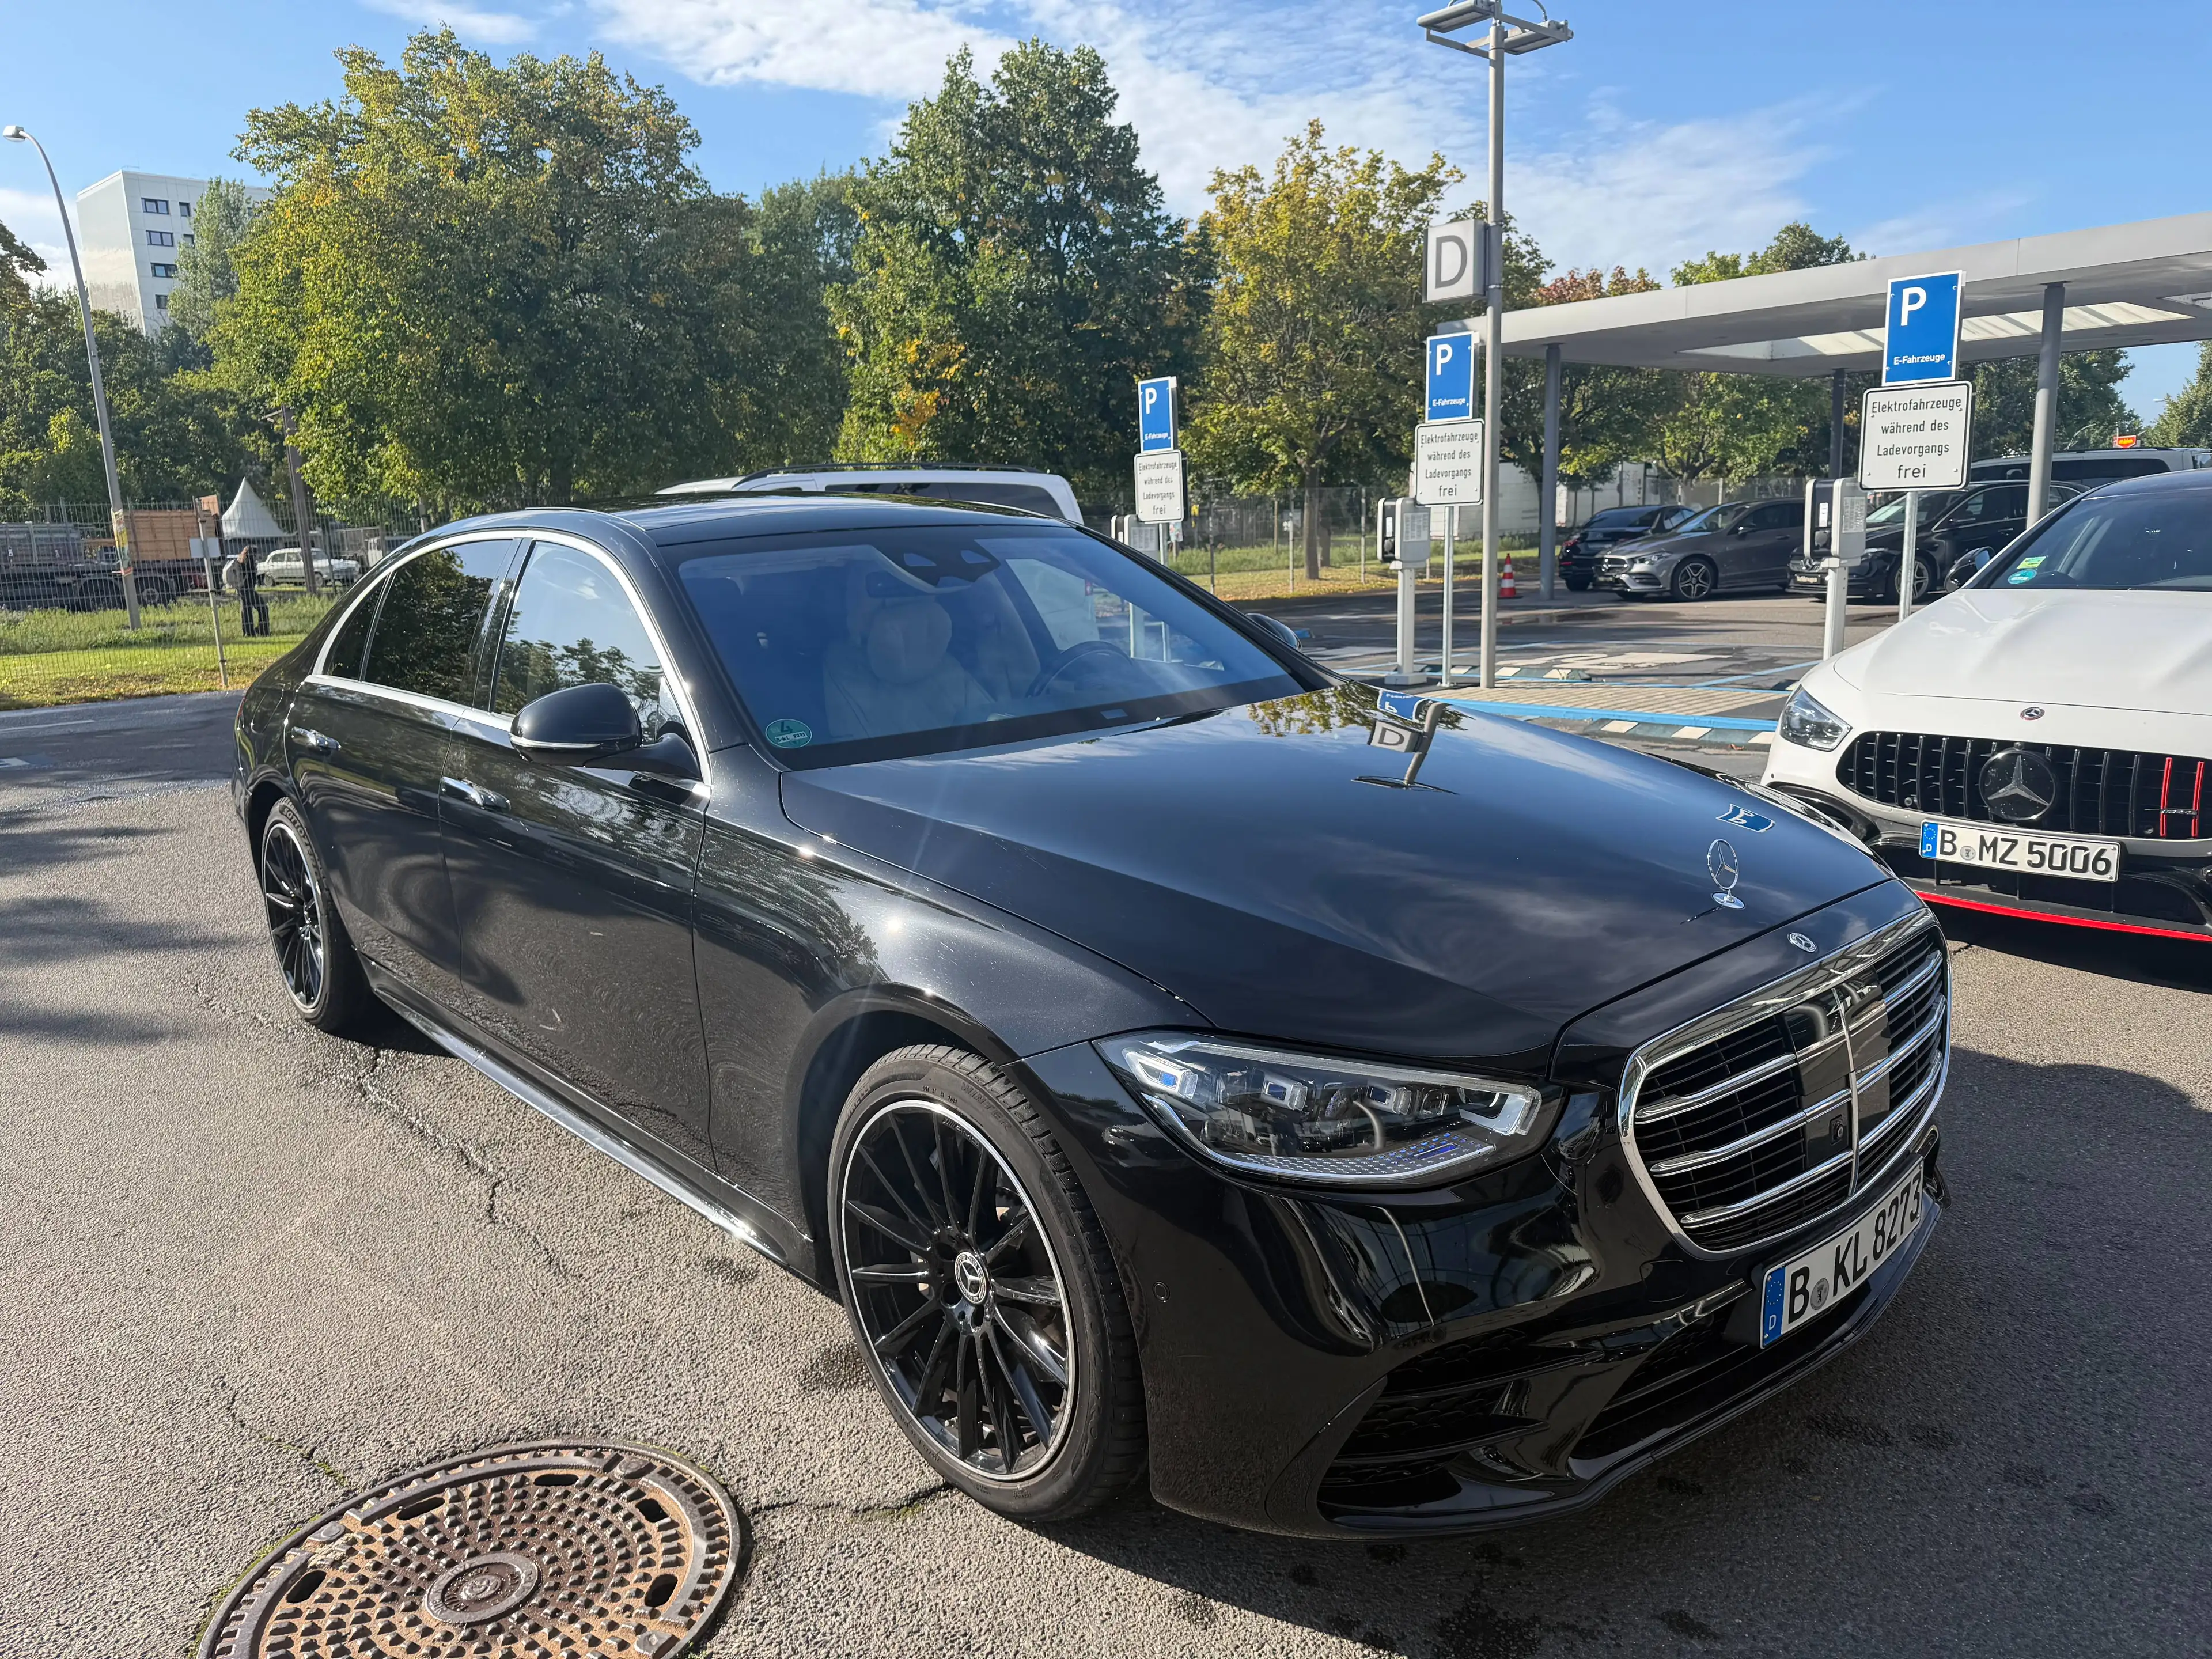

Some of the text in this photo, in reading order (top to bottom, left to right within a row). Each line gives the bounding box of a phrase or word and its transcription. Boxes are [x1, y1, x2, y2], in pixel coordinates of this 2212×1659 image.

[1435, 235, 1468, 289] D
[1900, 287, 1927, 326] P
[1436, 344, 1453, 376] P
[1893, 354, 1945, 365] E-Fahrzeuge
[1145, 387, 1157, 415] P
[1432, 397, 1466, 407] E-Fahrzeuge
[1872, 398, 1961, 414] Elektrofahrzeuge
[1881, 419, 1949, 434] während des
[1421, 433, 1478, 444] Elektrofahrzeuge
[1427, 449, 1471, 461] während des
[1877, 444, 1950, 457] Ladevorgangs
[1139, 462, 1177, 471] Elektrofahrzeuge
[1897, 463, 1926, 479] frei
[1144, 475, 1173, 485] während des
[1425, 469, 1472, 479] Ladevorgangs
[1143, 491, 1175, 501] Ladevorgangs
[1439, 484, 1457, 497] frei
[1153, 504, 1166, 514] frei
[1940, 830, 2112, 876] B MZ 5006
[1788, 1173, 1921, 1324] B KL 8273
[1768, 1314, 1777, 1330] D
